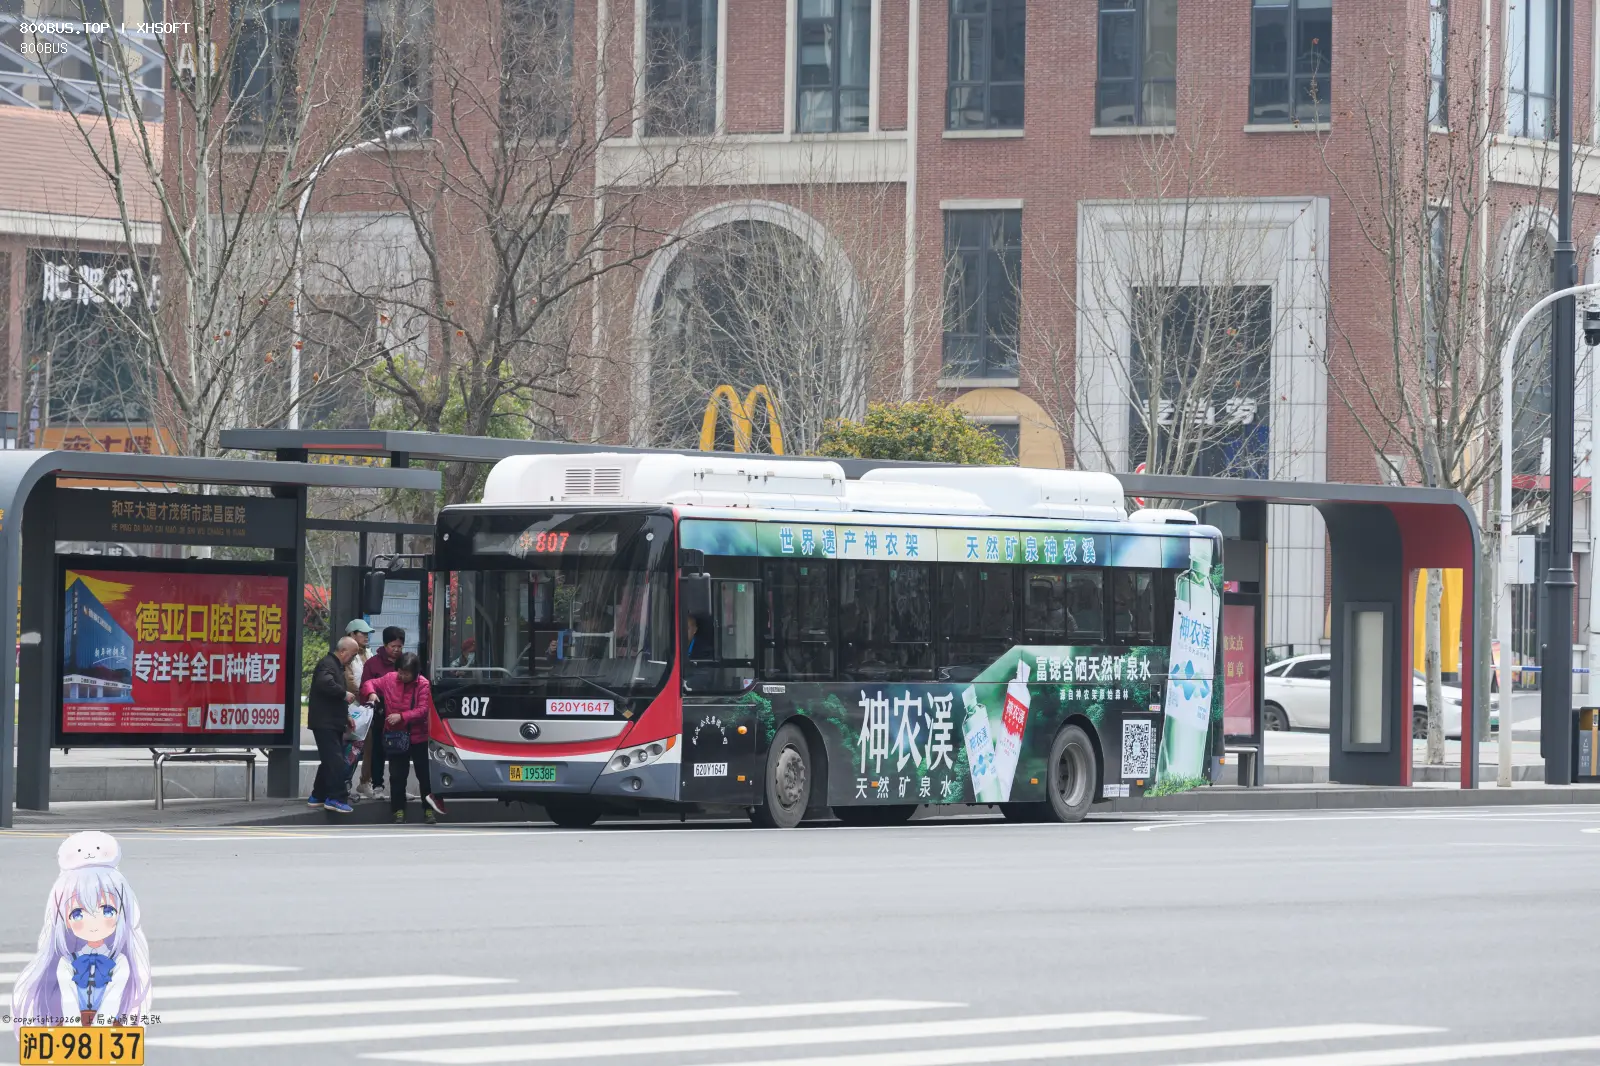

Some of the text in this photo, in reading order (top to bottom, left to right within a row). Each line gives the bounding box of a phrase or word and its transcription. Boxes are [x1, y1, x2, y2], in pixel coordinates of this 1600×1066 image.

[111, 500, 246, 524] 和平大道才茂街市武昌医院
[535, 532, 570, 553] 807
[779, 526, 1097, 564] 世界遗产神农架 天然矿泉神农溪
[135, 600, 282, 644] 德亚口腔医院
[134, 650, 281, 683] 专注半全口种植牙
[1035, 655, 1151, 682] 富锶含硒天然矿泉水
[220, 708, 280, 725] 8700 9999
[461, 697, 490, 716] 807
[550, 702, 610, 713] 620Y1647
[857, 689, 954, 774] 神农溪
[695, 764, 726, 776] 620Y1647
[855, 775, 952, 799] 天然矿泉水
